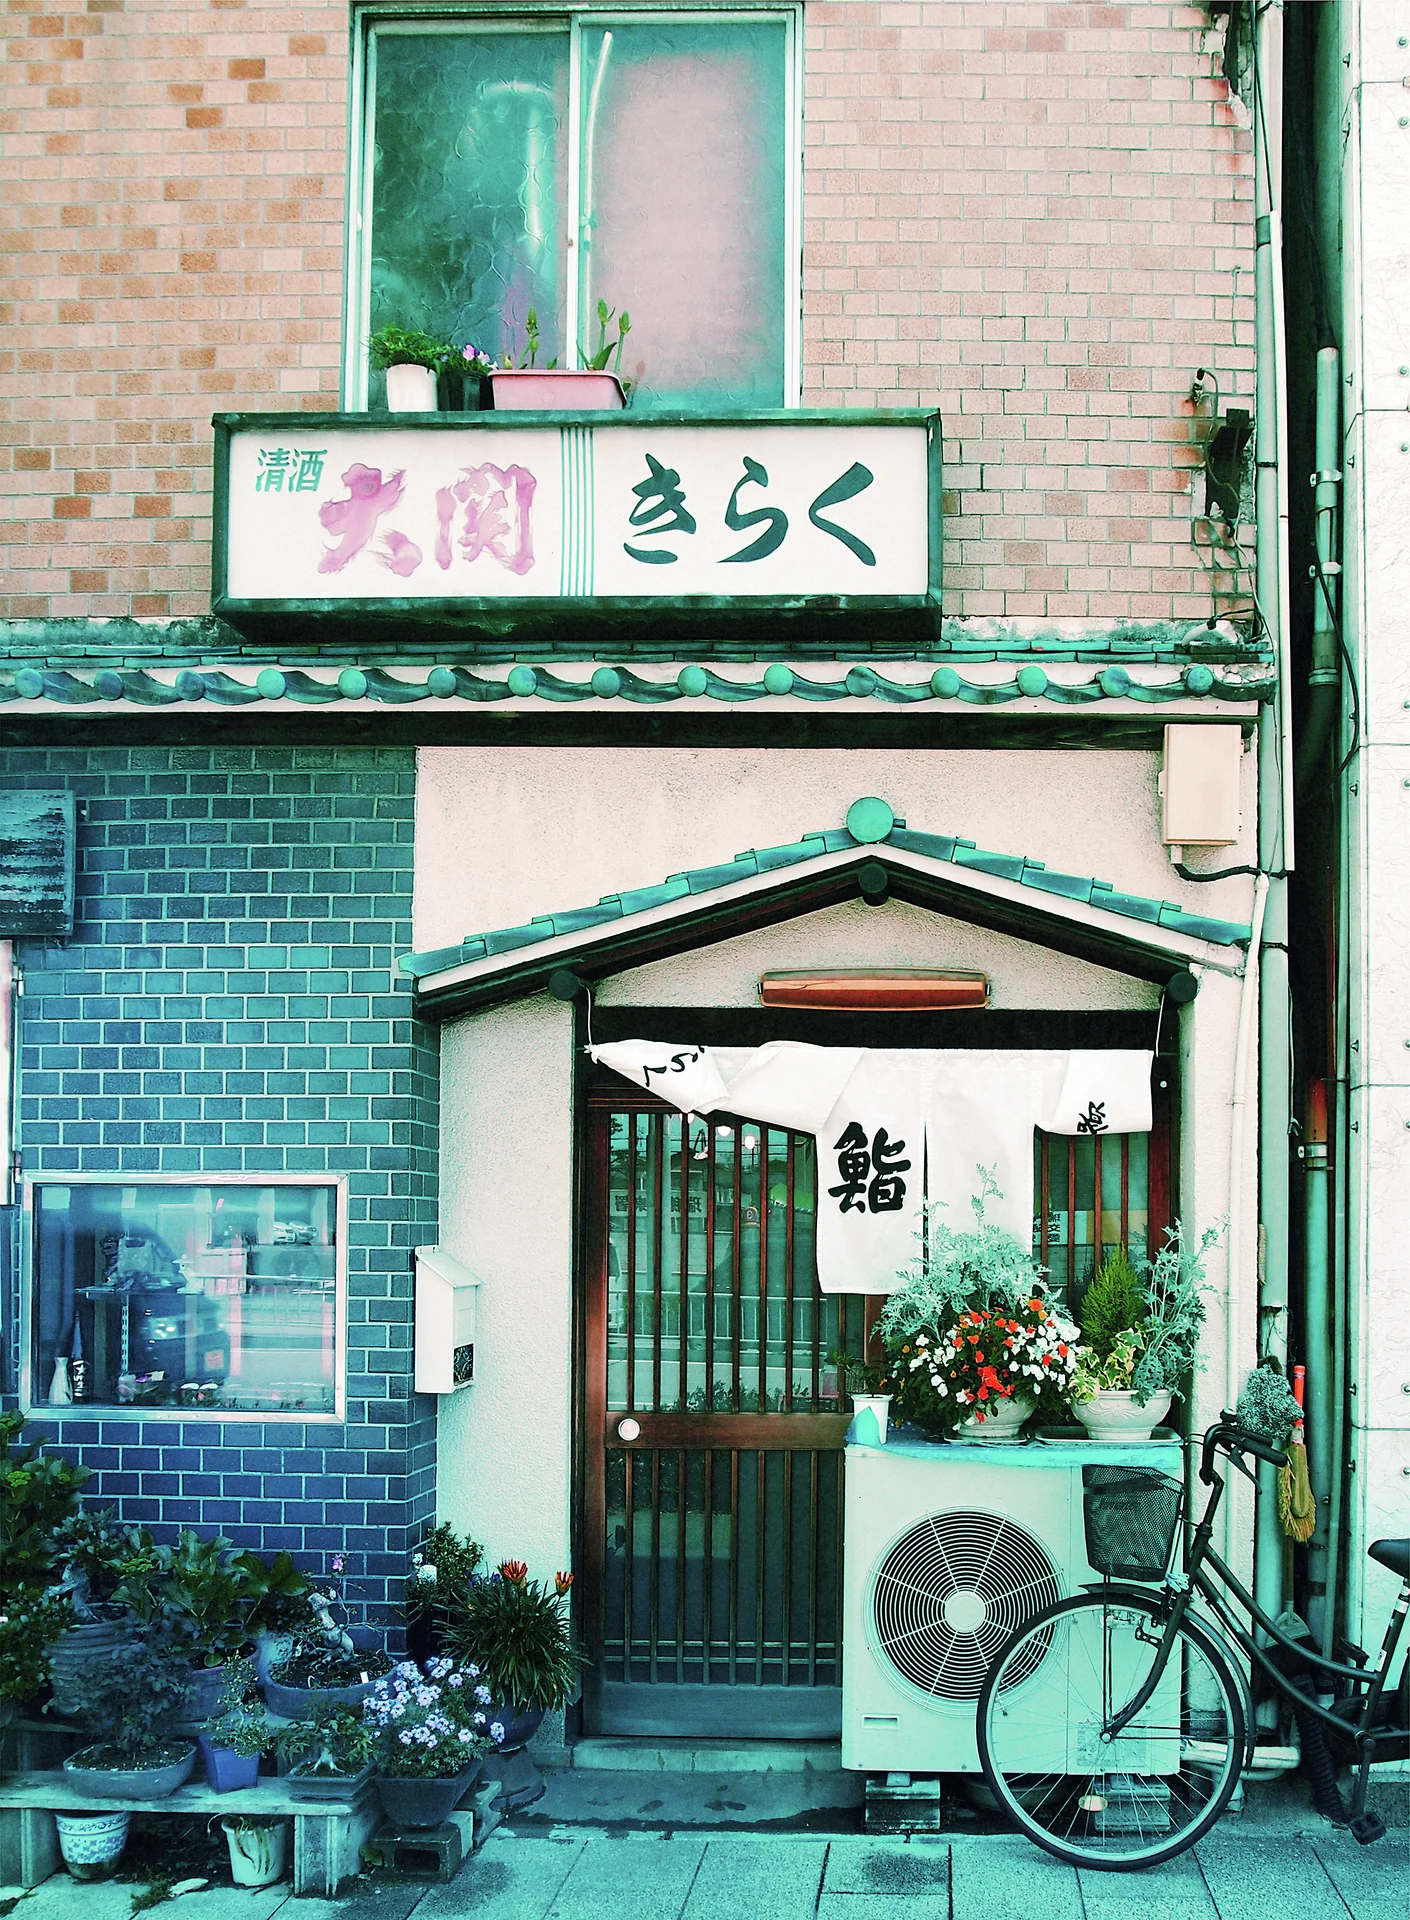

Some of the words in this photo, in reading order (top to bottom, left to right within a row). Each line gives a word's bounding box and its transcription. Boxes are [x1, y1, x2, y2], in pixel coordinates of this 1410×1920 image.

[255, 447, 328, 492] 清酒
[318, 462, 538, 578] 大関
[623, 453, 877, 567] きらく
[827, 1121, 912, 1214] 鮨
